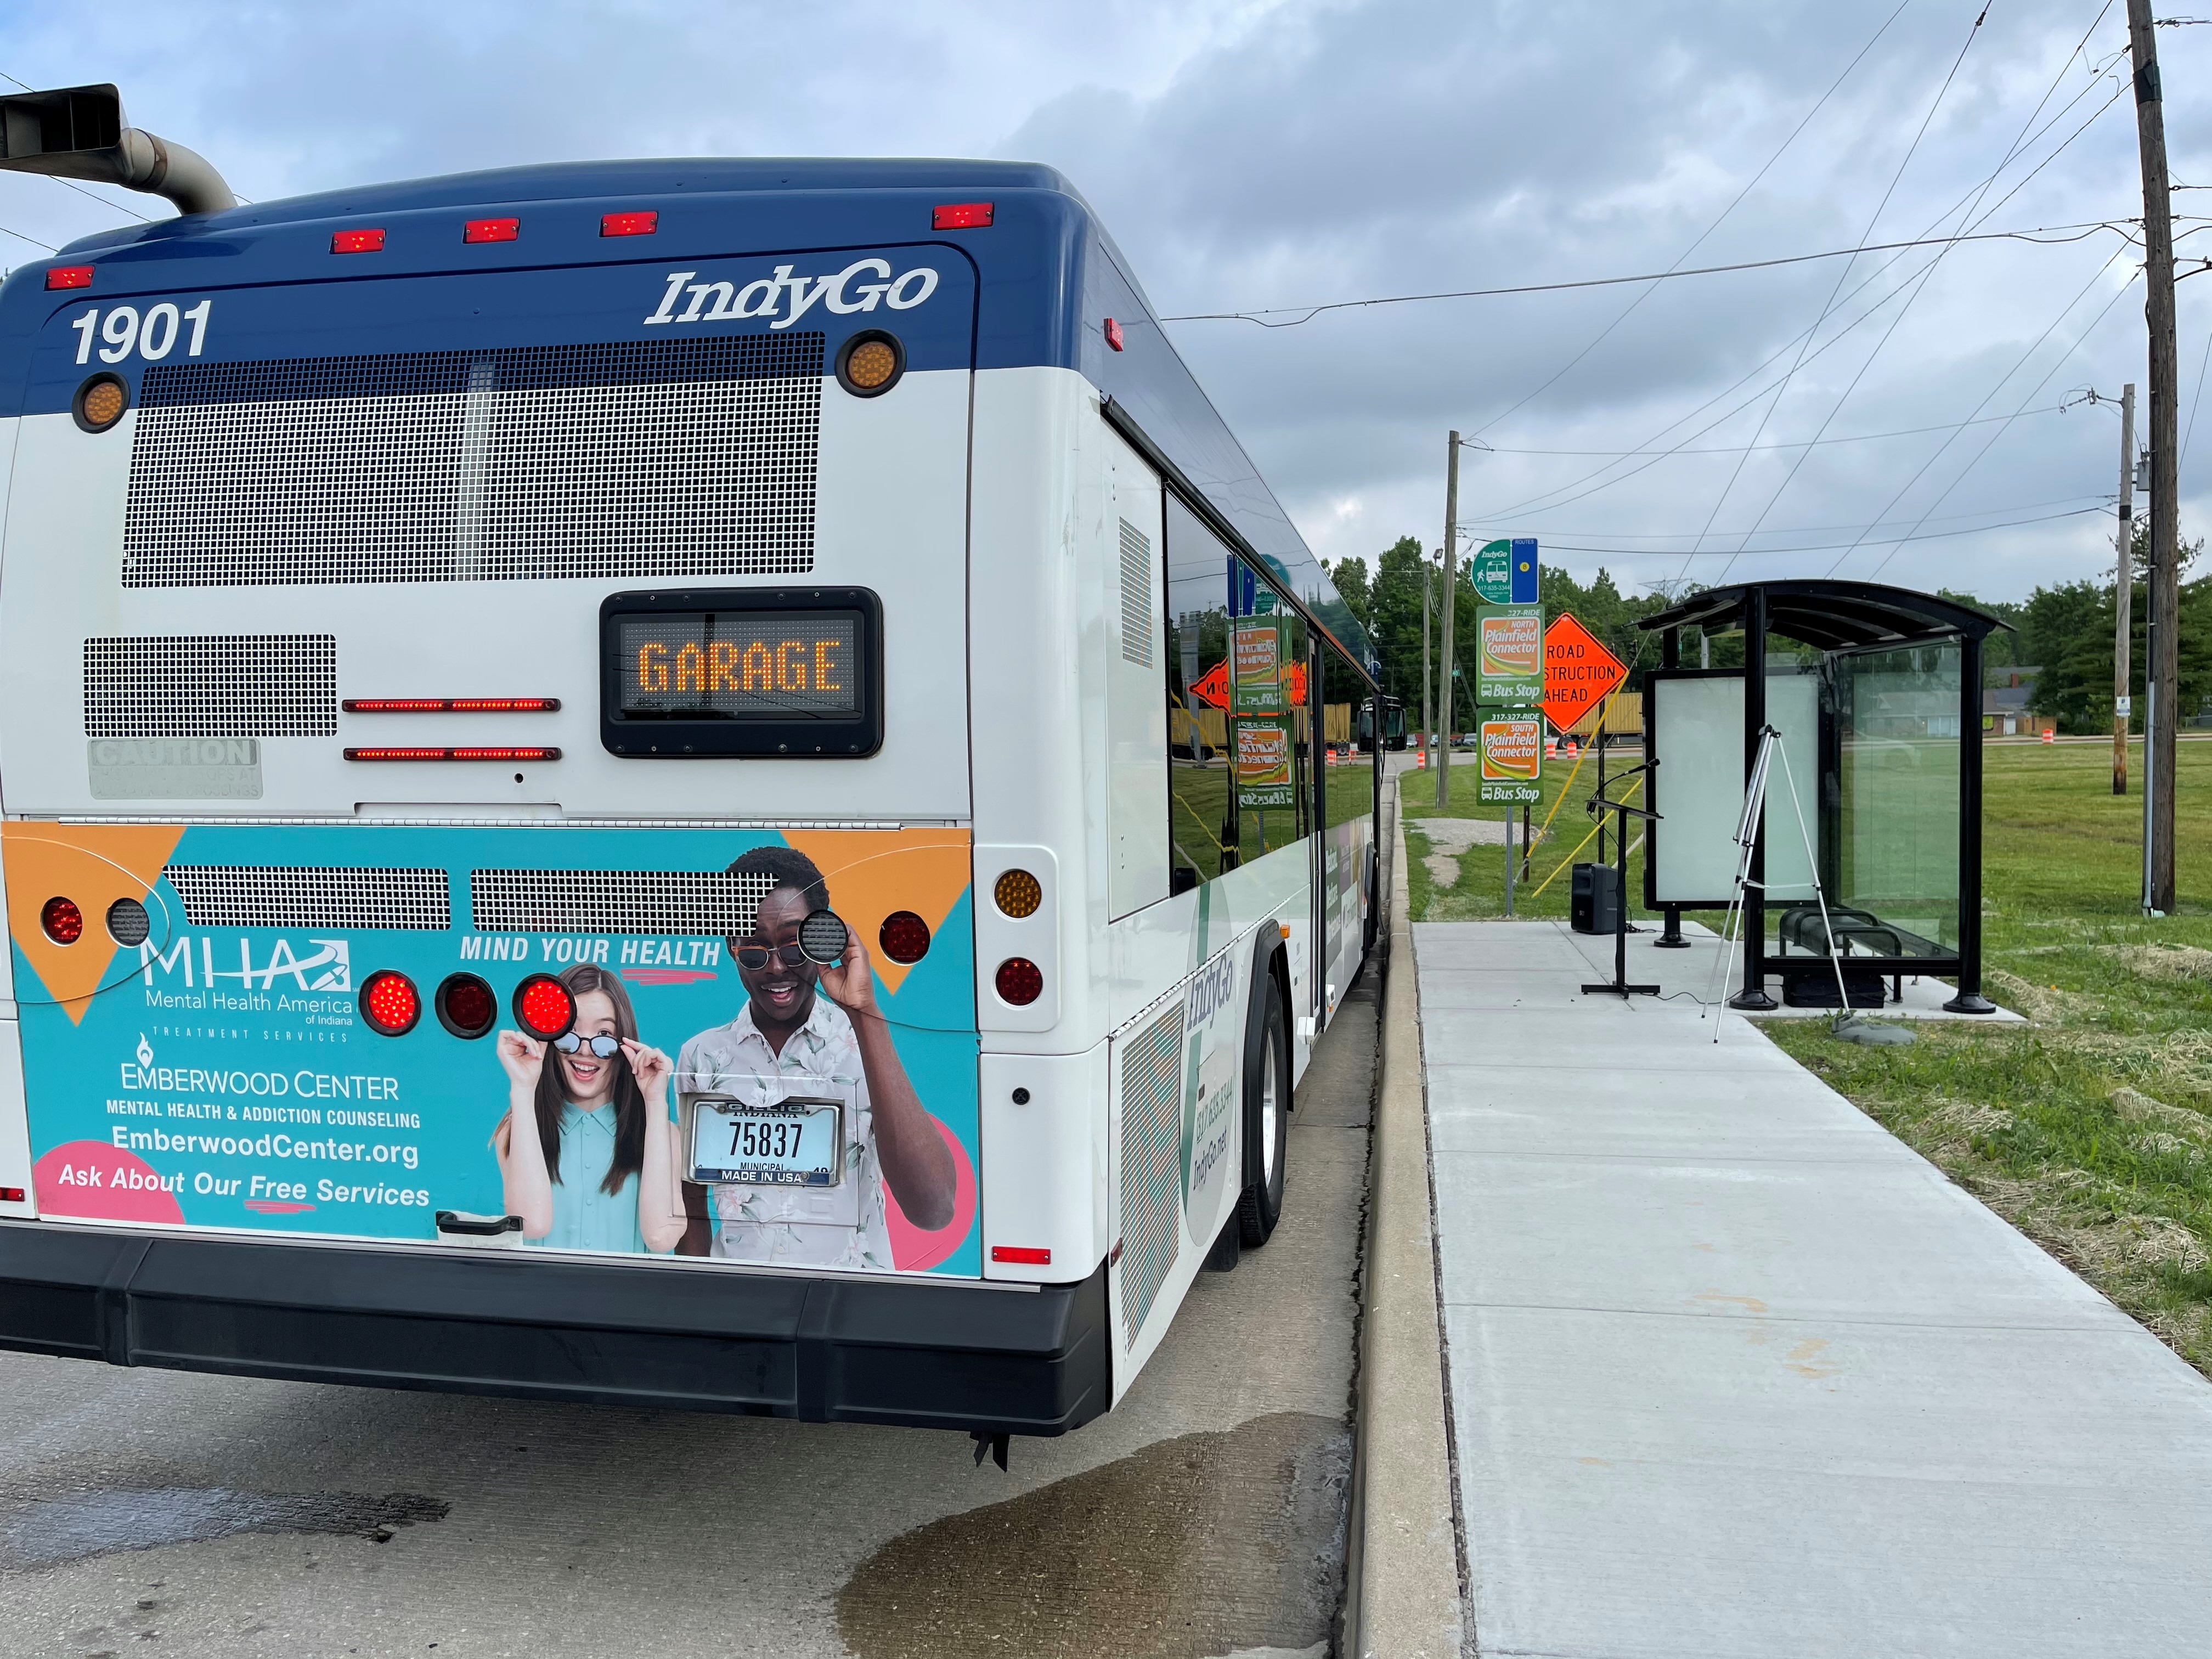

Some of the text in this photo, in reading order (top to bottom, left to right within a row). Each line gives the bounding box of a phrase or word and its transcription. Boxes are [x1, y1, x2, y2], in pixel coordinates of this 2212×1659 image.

[643, 258, 939, 330] IndyGo
[72, 300, 211, 365] 1901
[1481, 550, 1508, 558] IndyGo
[1485, 629, 1537, 642] Plainfield
[1486, 641, 1537, 654] Connector
[1547, 645, 1584, 658] ROAD
[639, 641, 840, 692] GARAGE
[1544, 666, 1615, 680] STRUCTION
[1493, 684, 1539, 699] Bus Stop
[1544, 689, 1588, 702] AHEAD
[1485, 732, 1537, 746] Plainfield
[97, 741, 251, 765] CAUTION
[1486, 744, 1537, 758] Connector
[1493, 787, 1540, 803] Bus Stop
[460, 936, 721, 966] MIND YOUR HEALTH
[139, 936, 311, 991] MHA
[146, 990, 353, 1014] Mental Health America
[1187, 953, 1233, 1032] IndyGo
[306, 1015, 353, 1026] of Indiana
[153, 1026, 347, 1042] TREATMENT SERVICES
[121, 1063, 399, 1101] EMBERWOOD CENTER
[106, 1099, 420, 1129] MENTAL HEALTH & ADDICTION COUNSELING
[727, 1103, 803, 1112] GILLIG
[111, 1125, 419, 1170] EmberwoodCenter.org
[729, 1121, 802, 1158] 75837
[1193, 1125, 1227, 1191] IndyGo.net
[58, 1164, 430, 1207] Ask About Our Free Services
[721, 1170, 802, 1183] MADE IN USA
